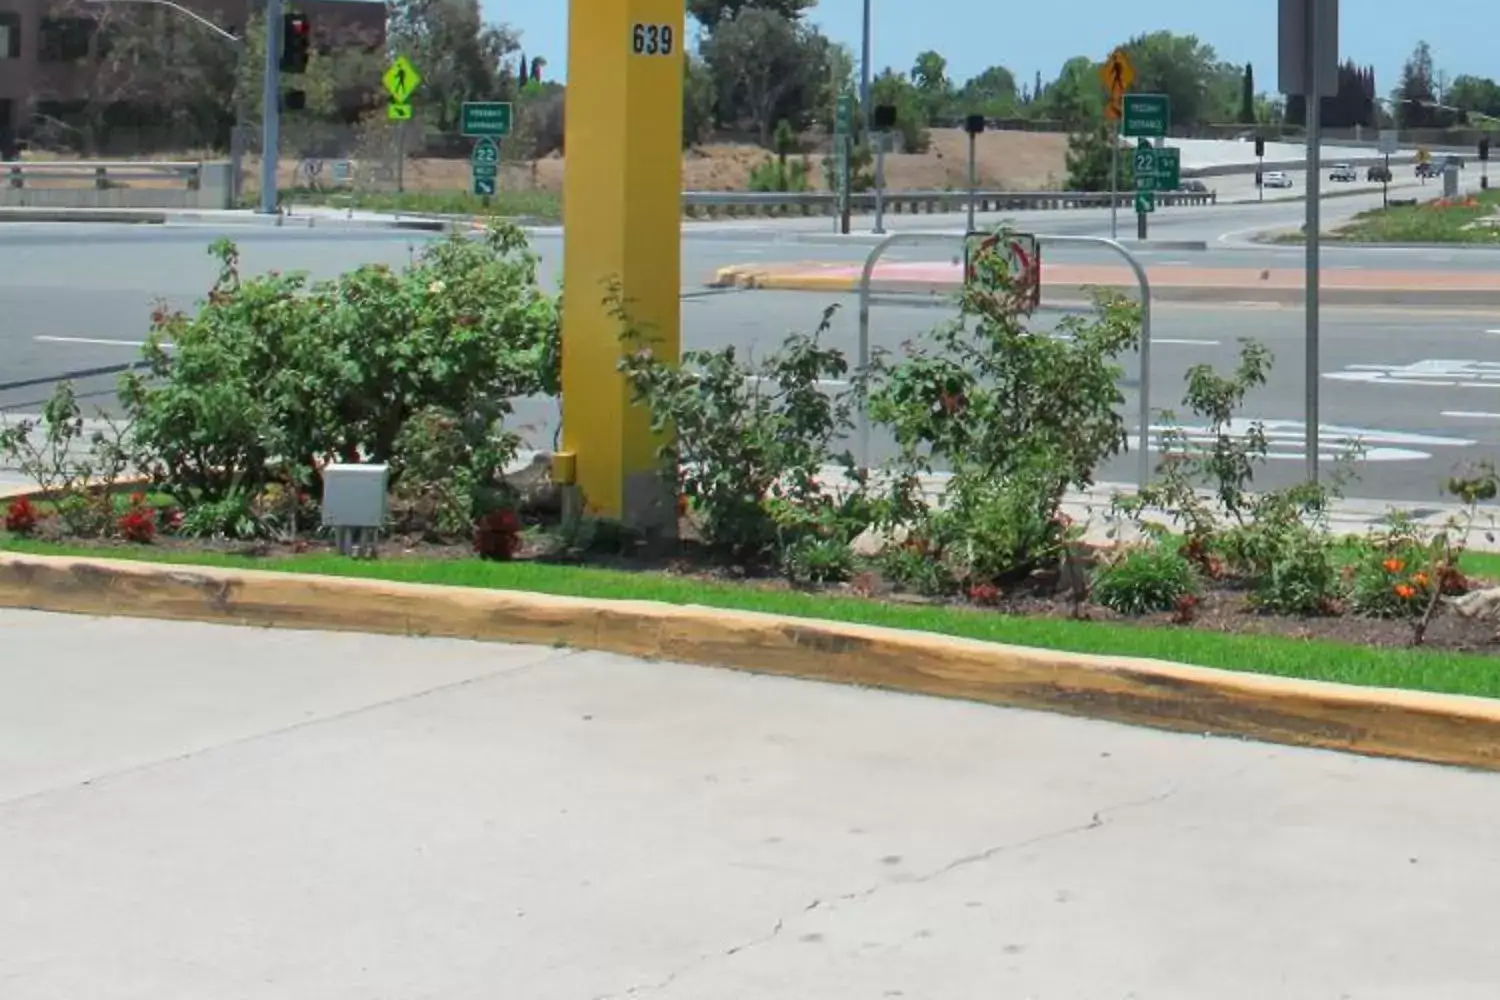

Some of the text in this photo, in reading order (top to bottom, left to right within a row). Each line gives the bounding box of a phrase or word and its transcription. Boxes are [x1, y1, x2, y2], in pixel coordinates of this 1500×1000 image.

[633, 23, 672, 55] 639
[477, 149, 495, 161] 22
[1137, 155, 1153, 170] 22
